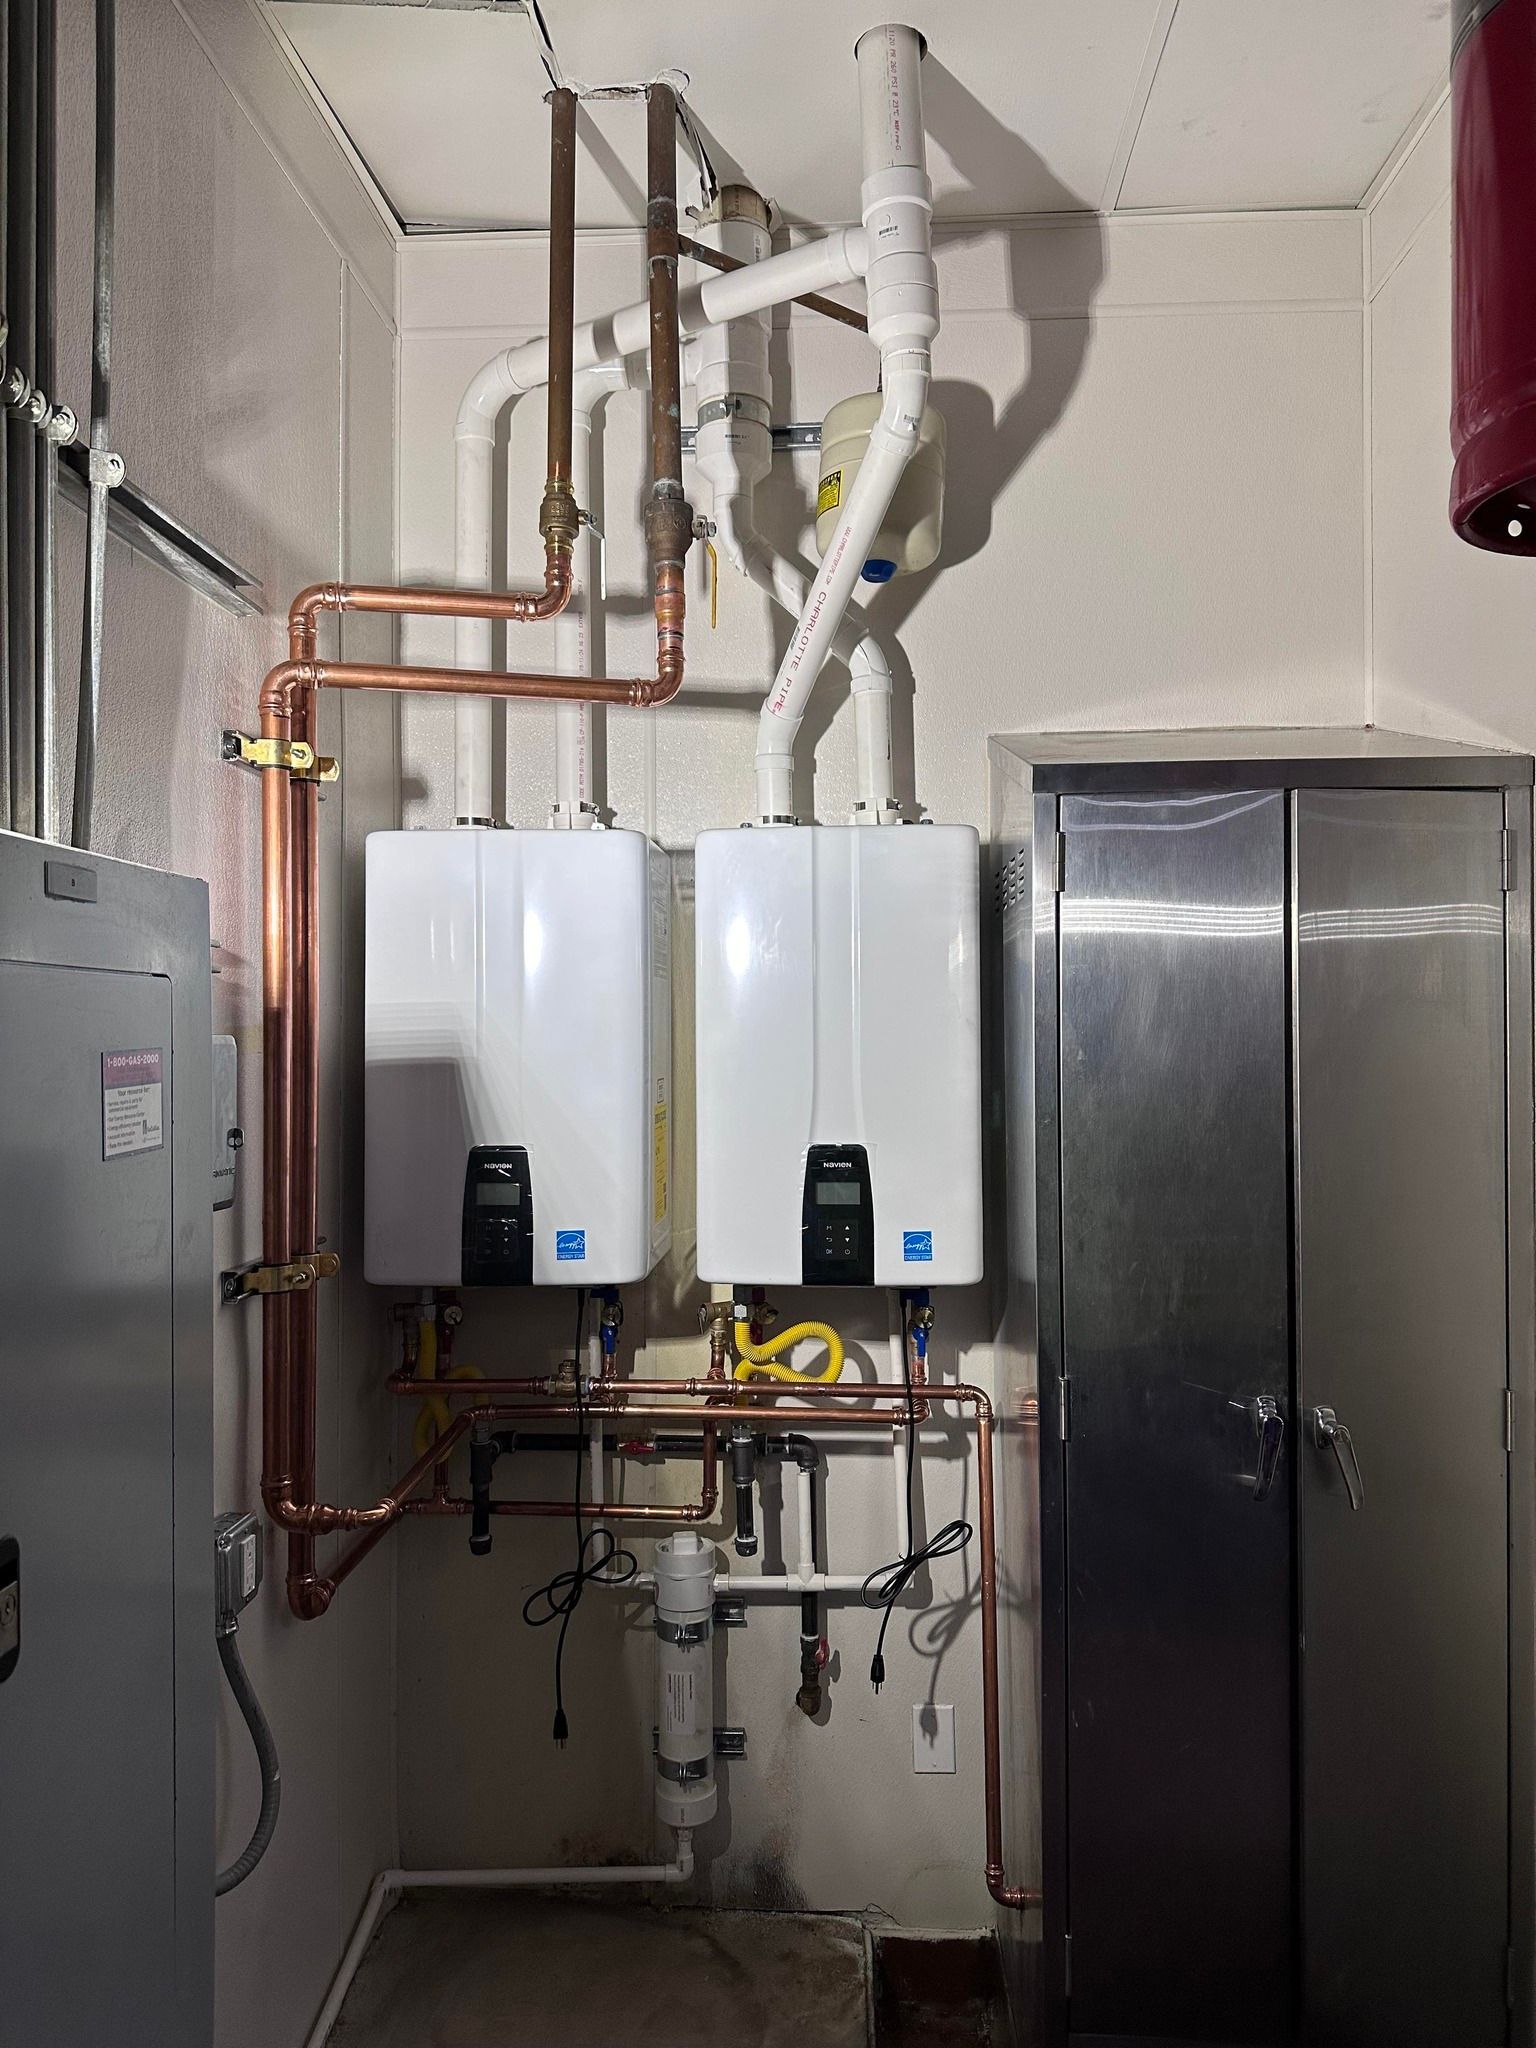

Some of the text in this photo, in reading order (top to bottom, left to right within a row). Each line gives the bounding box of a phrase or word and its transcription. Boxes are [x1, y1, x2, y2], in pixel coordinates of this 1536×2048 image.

[773, 591, 827, 712] CHARLOTTE PIPE
[107, 1054, 159, 1068] 1-800-GAS-2000
